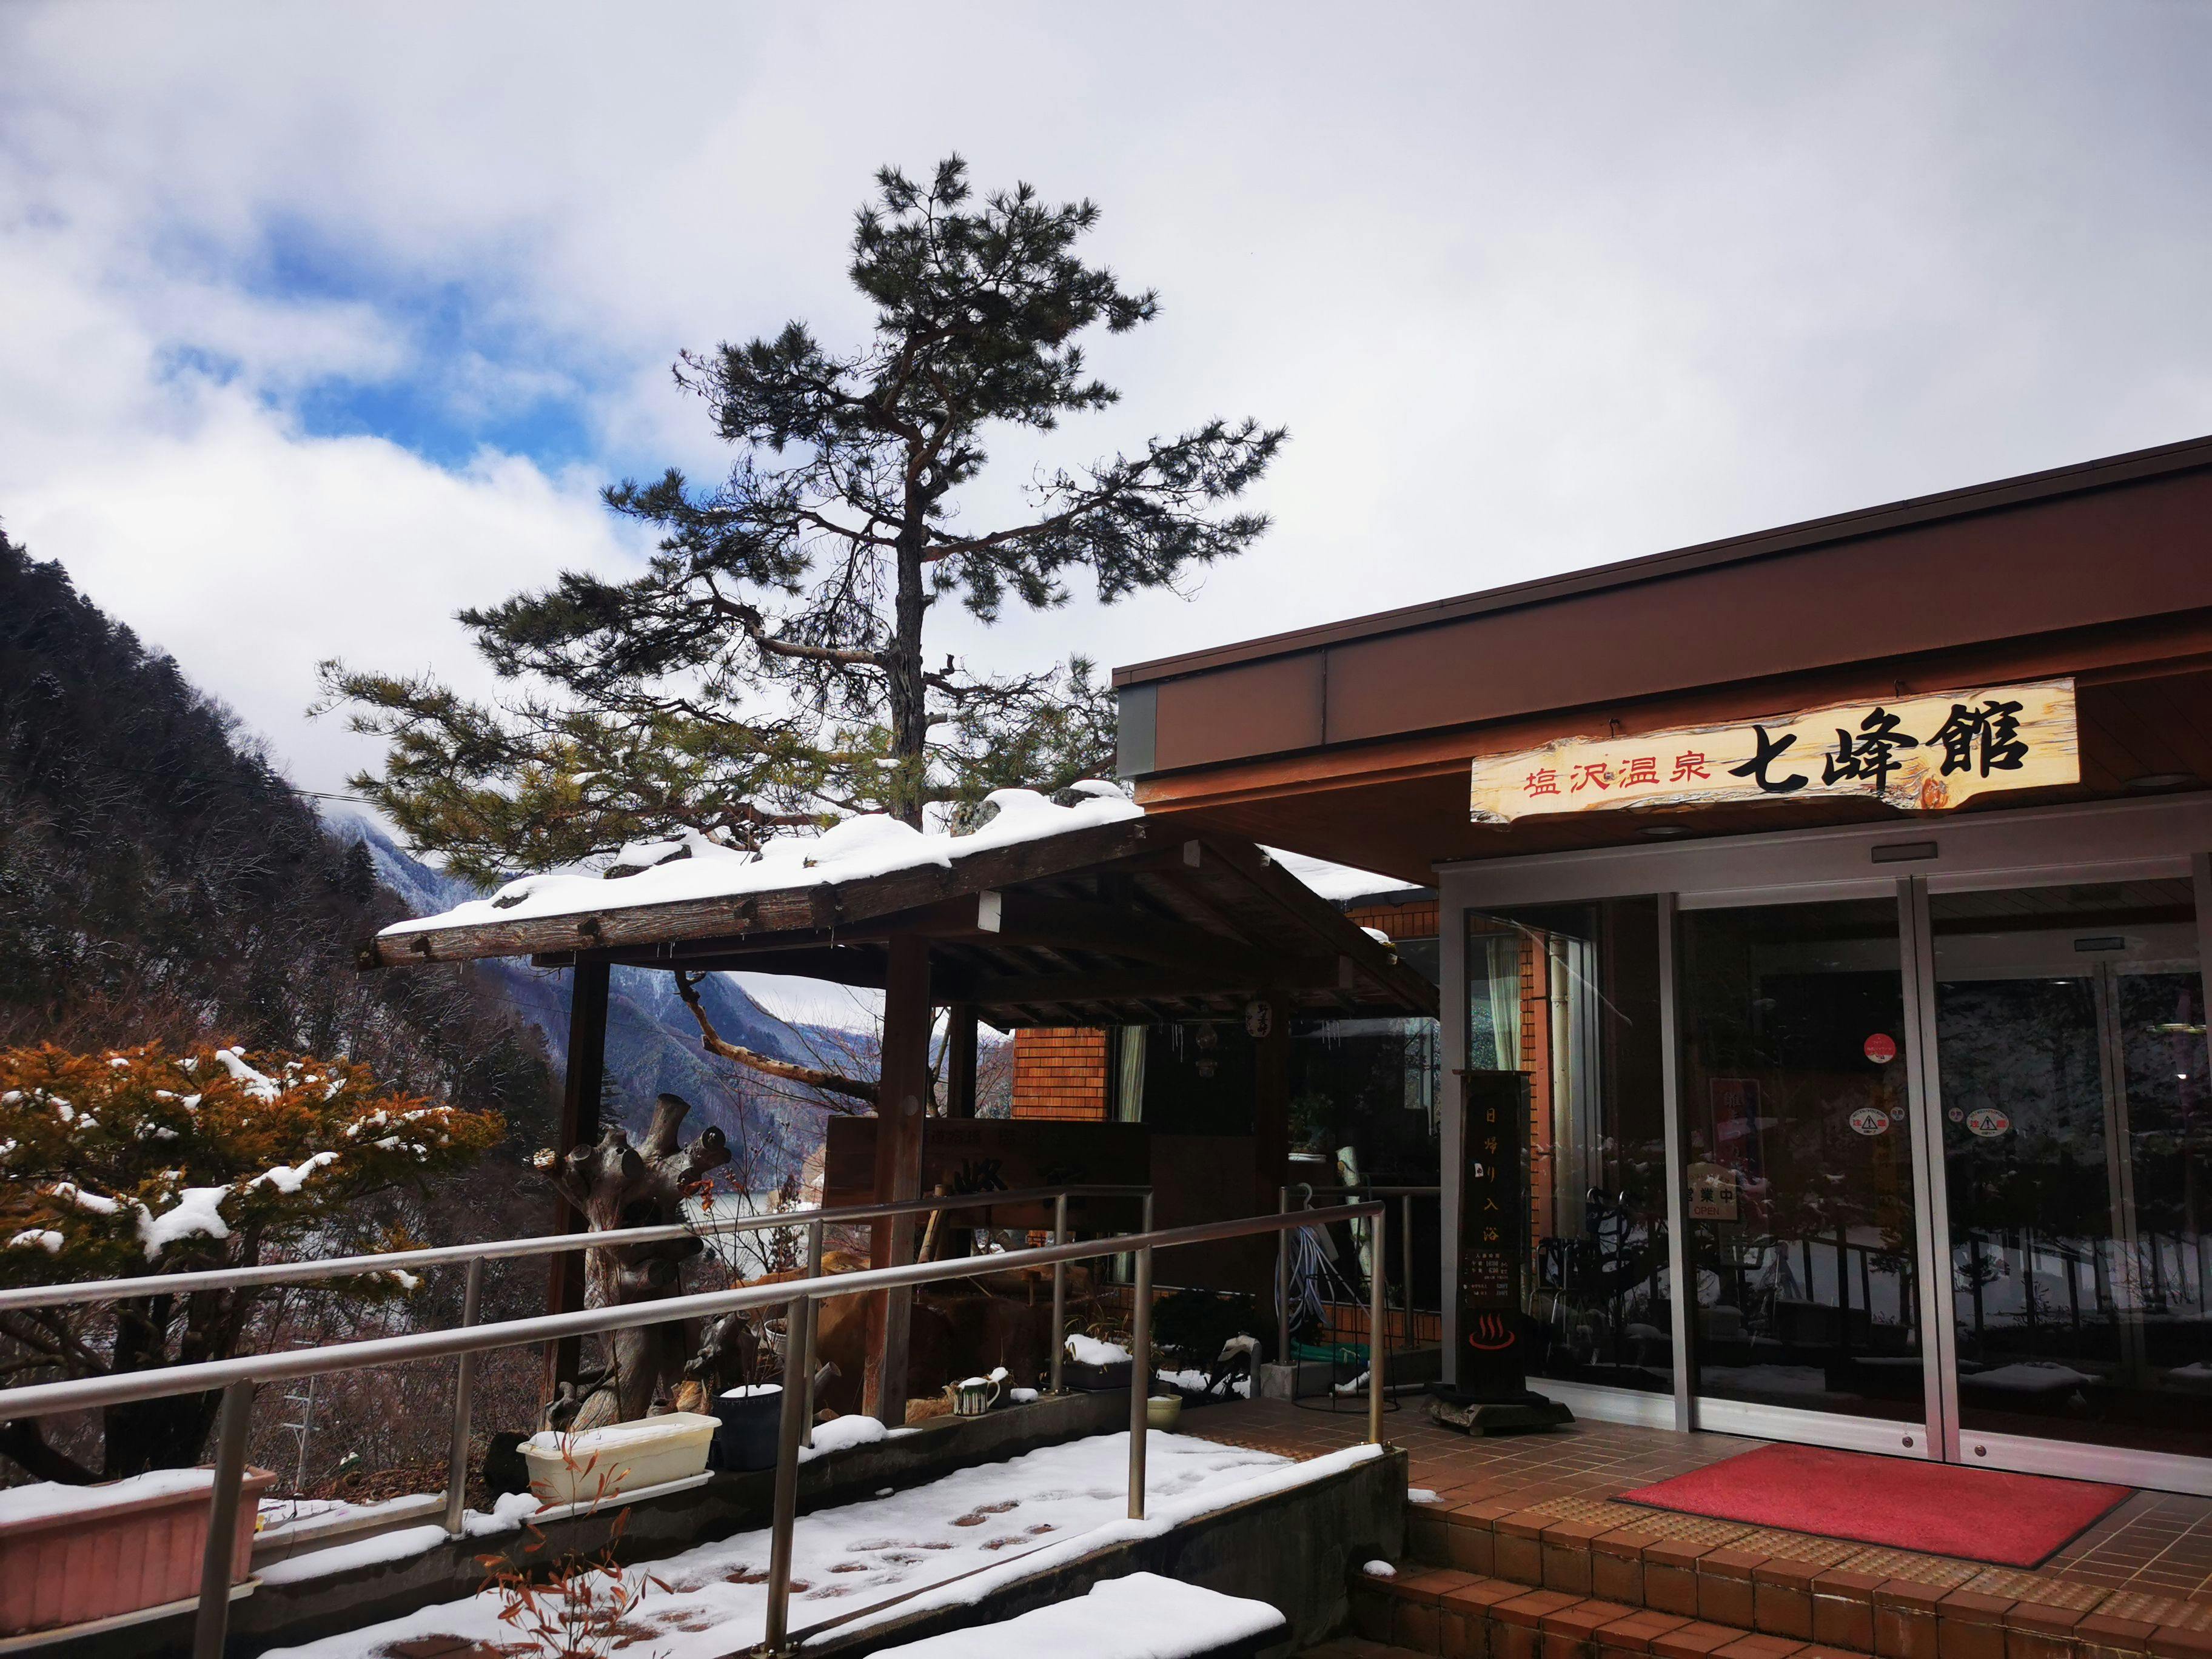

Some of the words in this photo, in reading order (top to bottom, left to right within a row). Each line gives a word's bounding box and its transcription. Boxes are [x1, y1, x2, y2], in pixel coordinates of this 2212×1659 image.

[1523, 749, 1712, 797] 塩沢温泉
[1728, 699, 2029, 794] 七峰館
[1483, 1108, 1500, 1242] 日帰り入浴
[1694, 1205, 1720, 1216] OPEN
